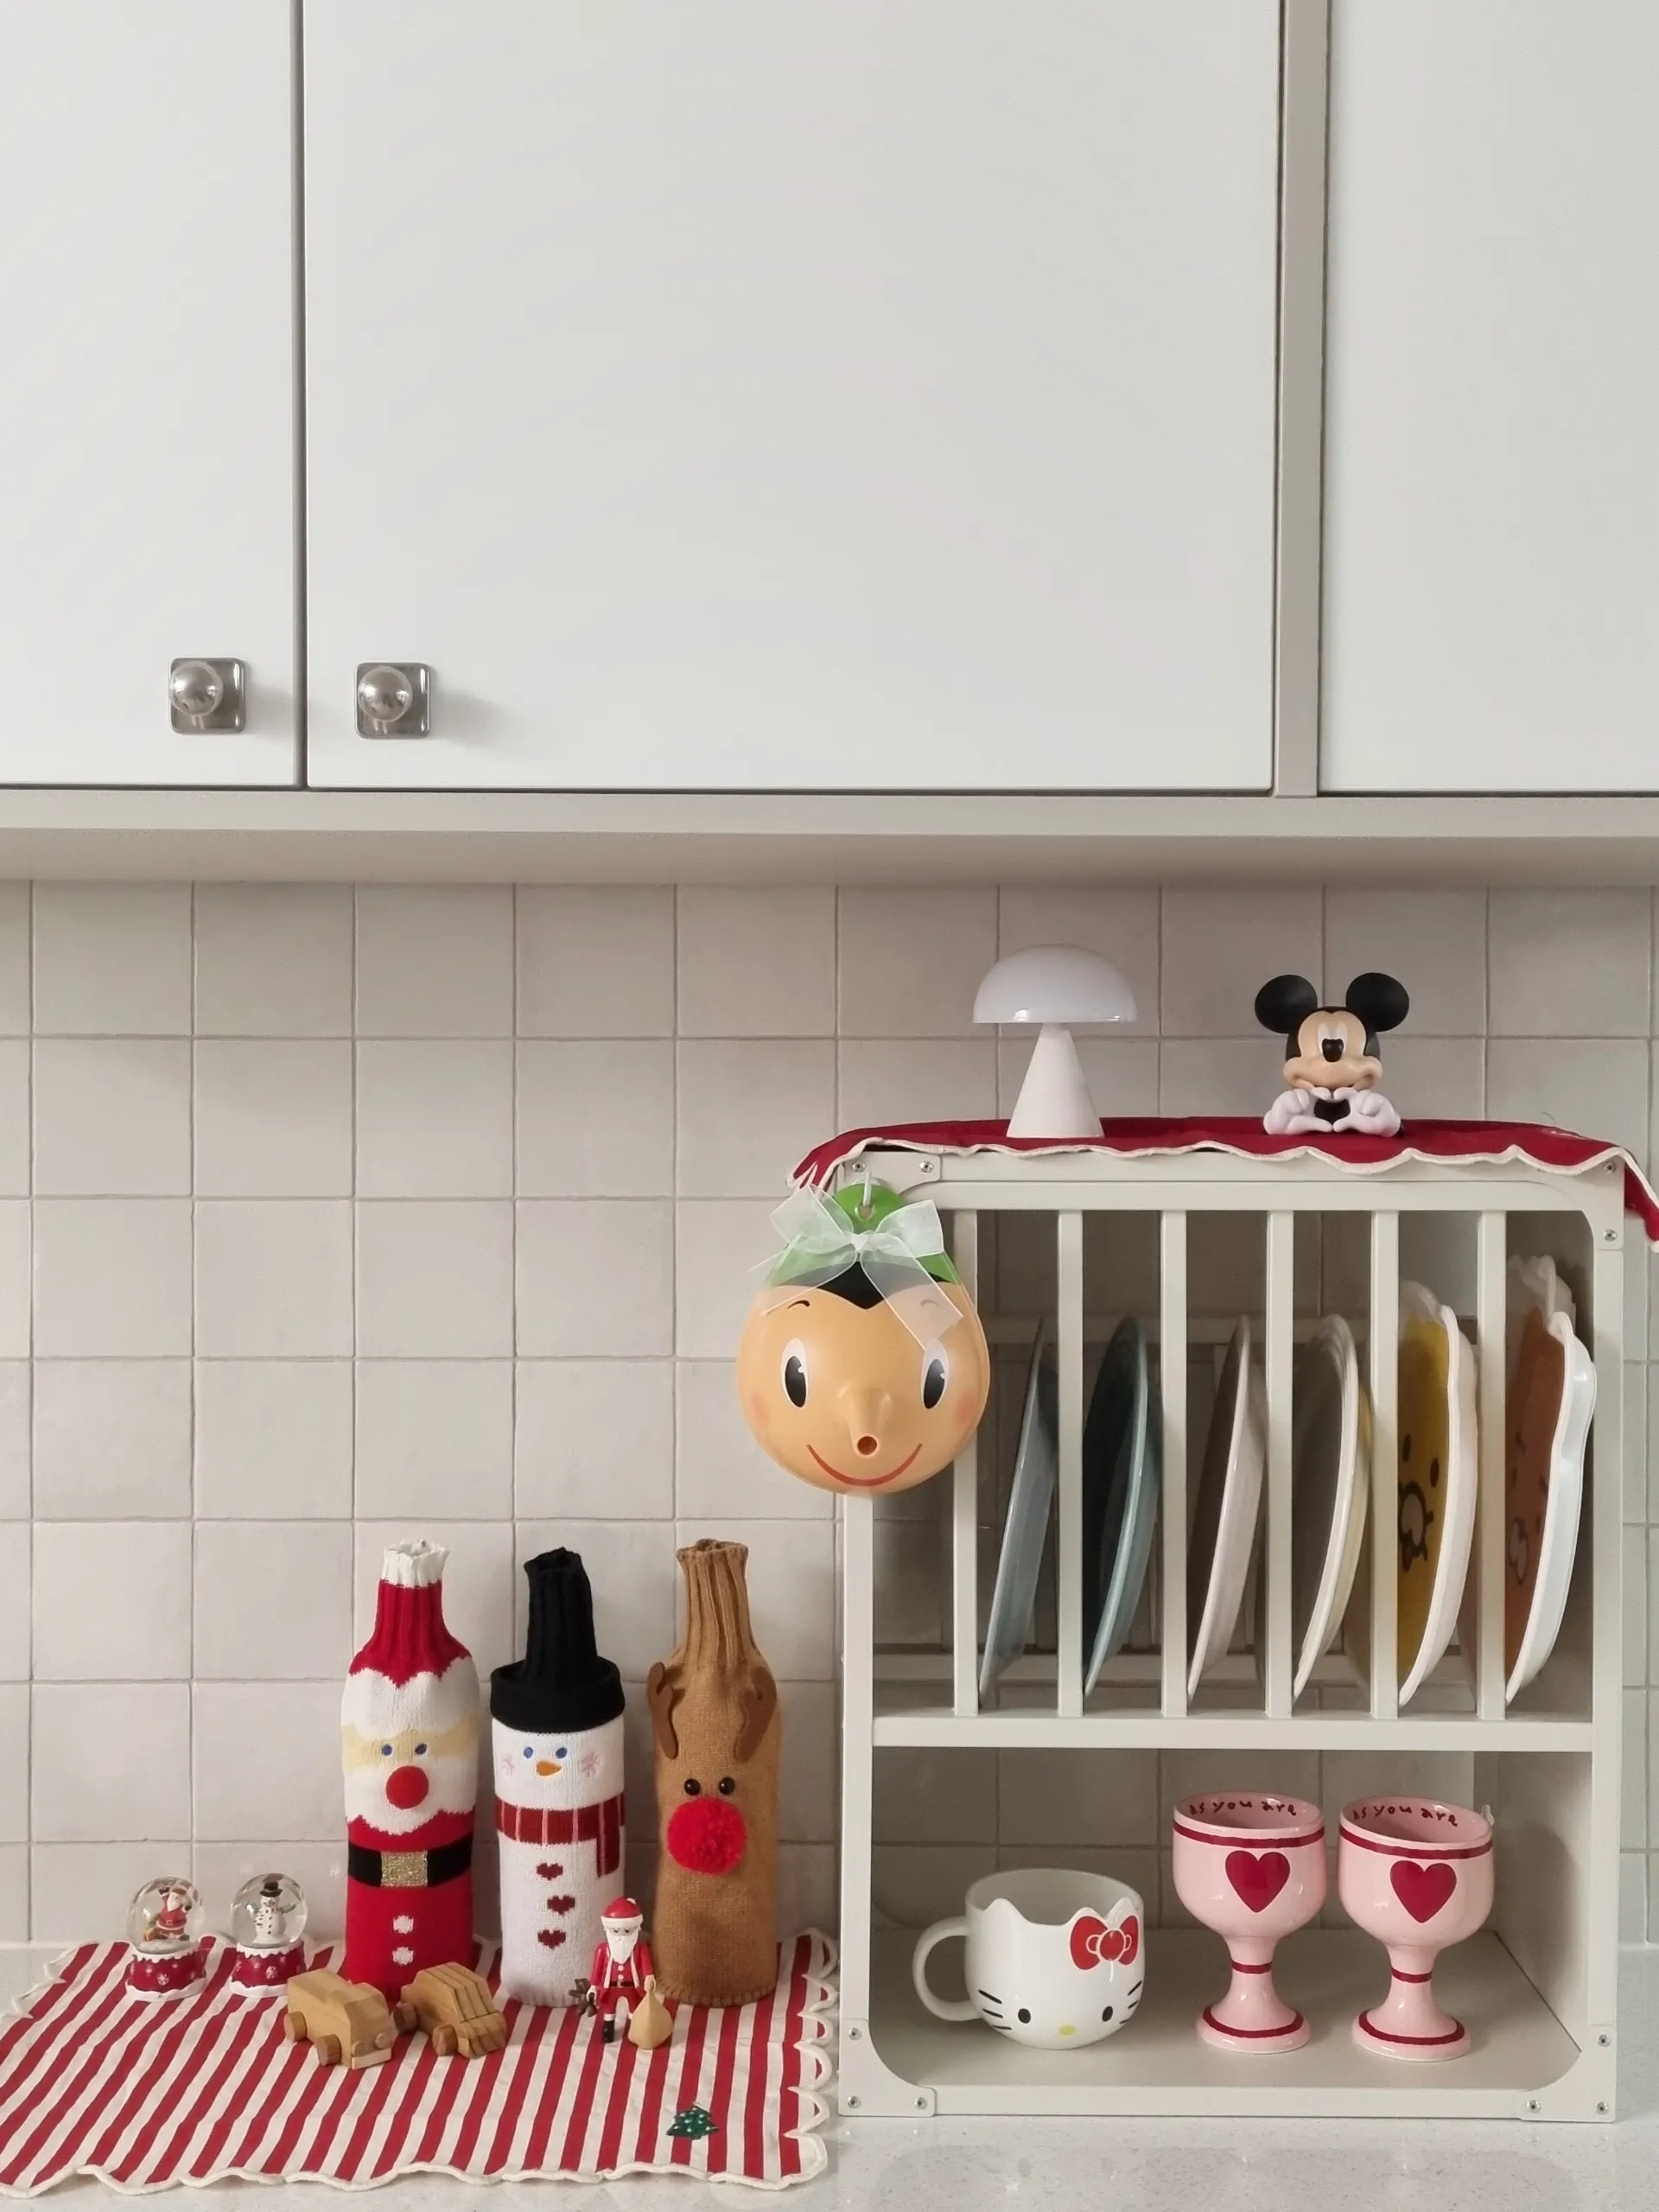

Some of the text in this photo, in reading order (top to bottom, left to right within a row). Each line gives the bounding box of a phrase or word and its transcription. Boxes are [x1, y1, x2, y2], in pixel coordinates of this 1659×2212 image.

[1212, 1800, 1253, 1813] you
[1262, 1801, 1297, 1816] are
[1374, 1805, 1413, 1817] you
[1421, 1808, 1459, 1827] are
